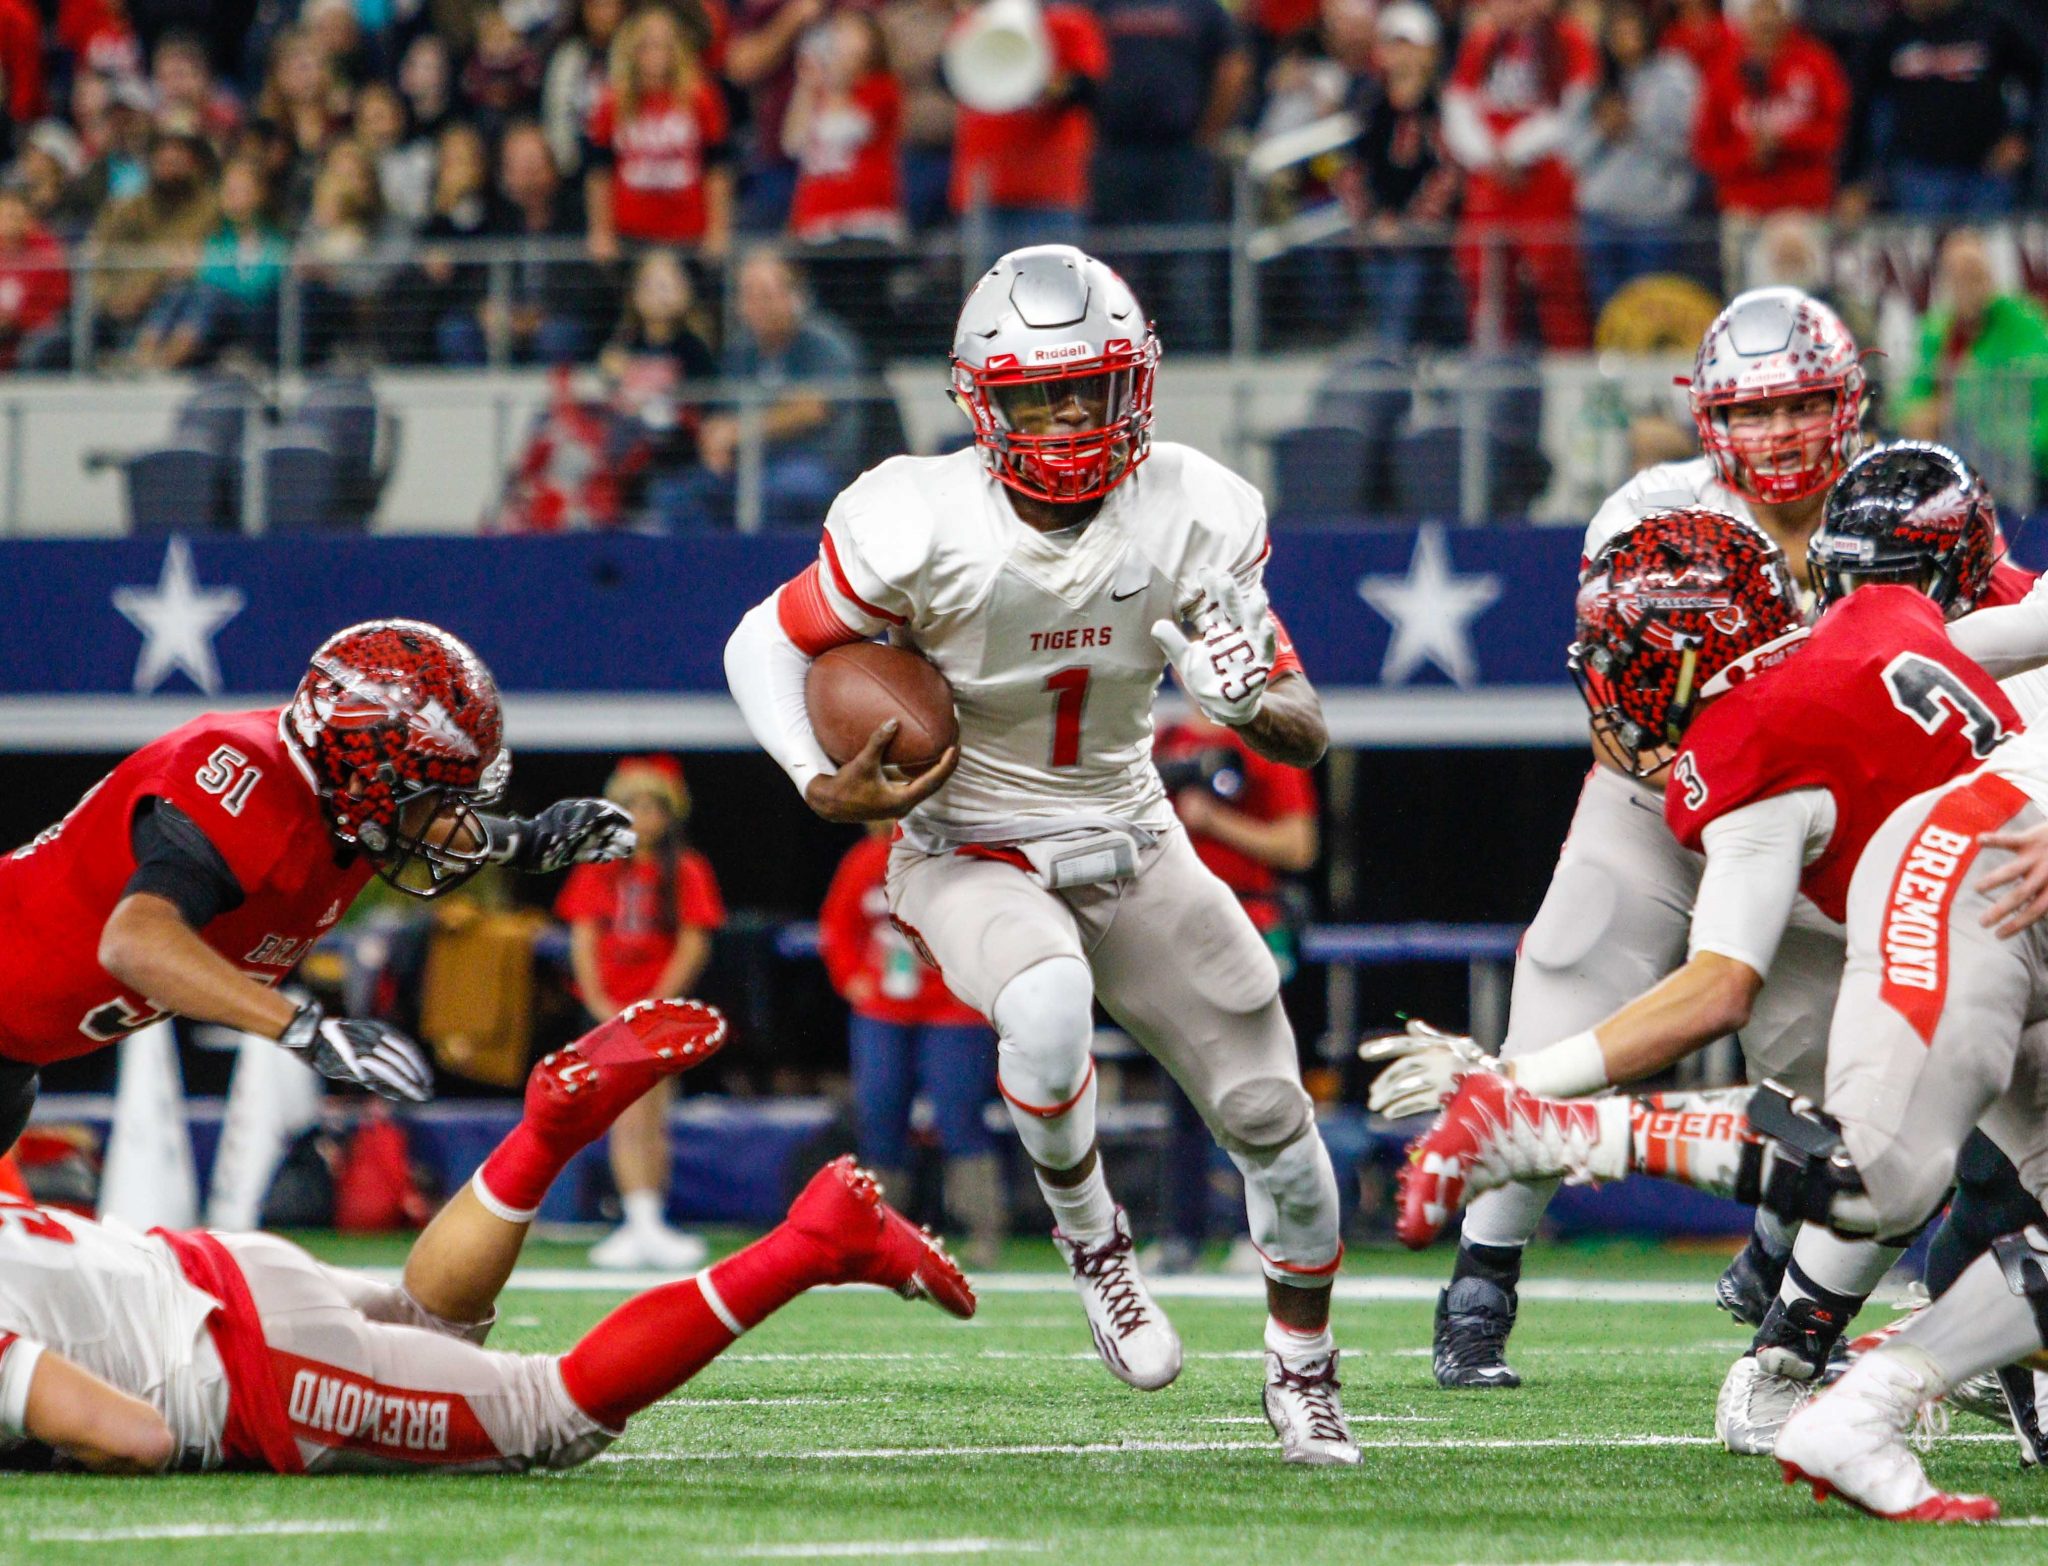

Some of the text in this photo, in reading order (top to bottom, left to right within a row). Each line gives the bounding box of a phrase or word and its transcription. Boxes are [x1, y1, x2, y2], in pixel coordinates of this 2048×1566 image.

[1035, 344, 1087, 361] Riddell
[1029, 627, 1112, 651] TIGERS
[1041, 664, 1092, 768] 1
[194, 743, 263, 817] 51
[1675, 750, 1708, 811] 3
[1886, 824, 1972, 992] BREMOND
[288, 1369, 449, 1451] BREMOND
